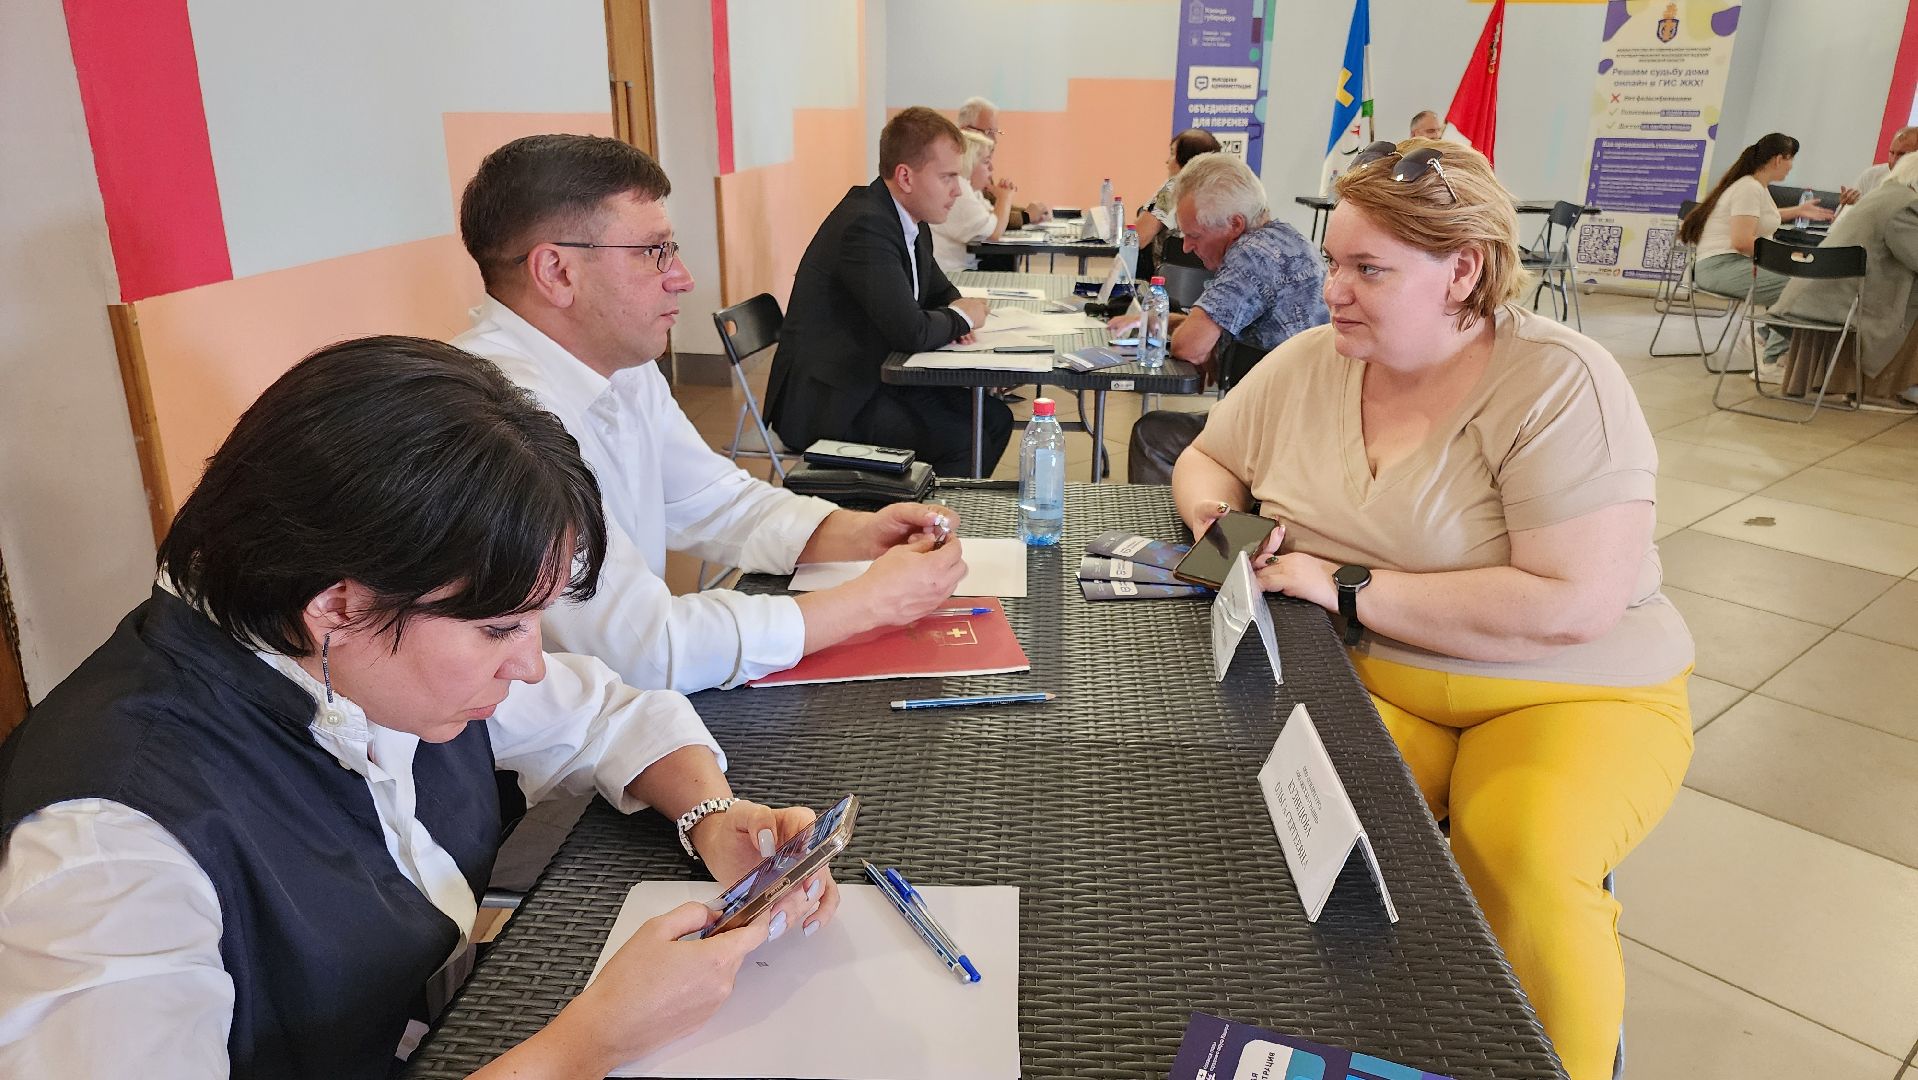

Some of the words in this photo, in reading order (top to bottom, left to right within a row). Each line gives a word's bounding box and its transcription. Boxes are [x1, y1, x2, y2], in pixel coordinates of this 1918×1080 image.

[1612, 68, 1648, 76] Решаем
[1650, 68, 1682, 77] судьбу
[1684, 68, 1710, 77] дома
[1658, 79, 1678, 87] ГИС
[1680, 79, 1704, 87] ЖКХ!
[1188, 104, 1254, 115] ОБЪЕДИНЯЕМСЯ
[1192, 117, 1210, 129] ДЛЯ
[1211, 117, 1249, 127] ПЕРЕМЕН
[1287, 778, 1312, 838] КУЗНЕЦОВА
[1275, 782, 1289, 815] ОЛЬГА
[1284, 810, 1309, 870] СЕРГЕЕВНА
